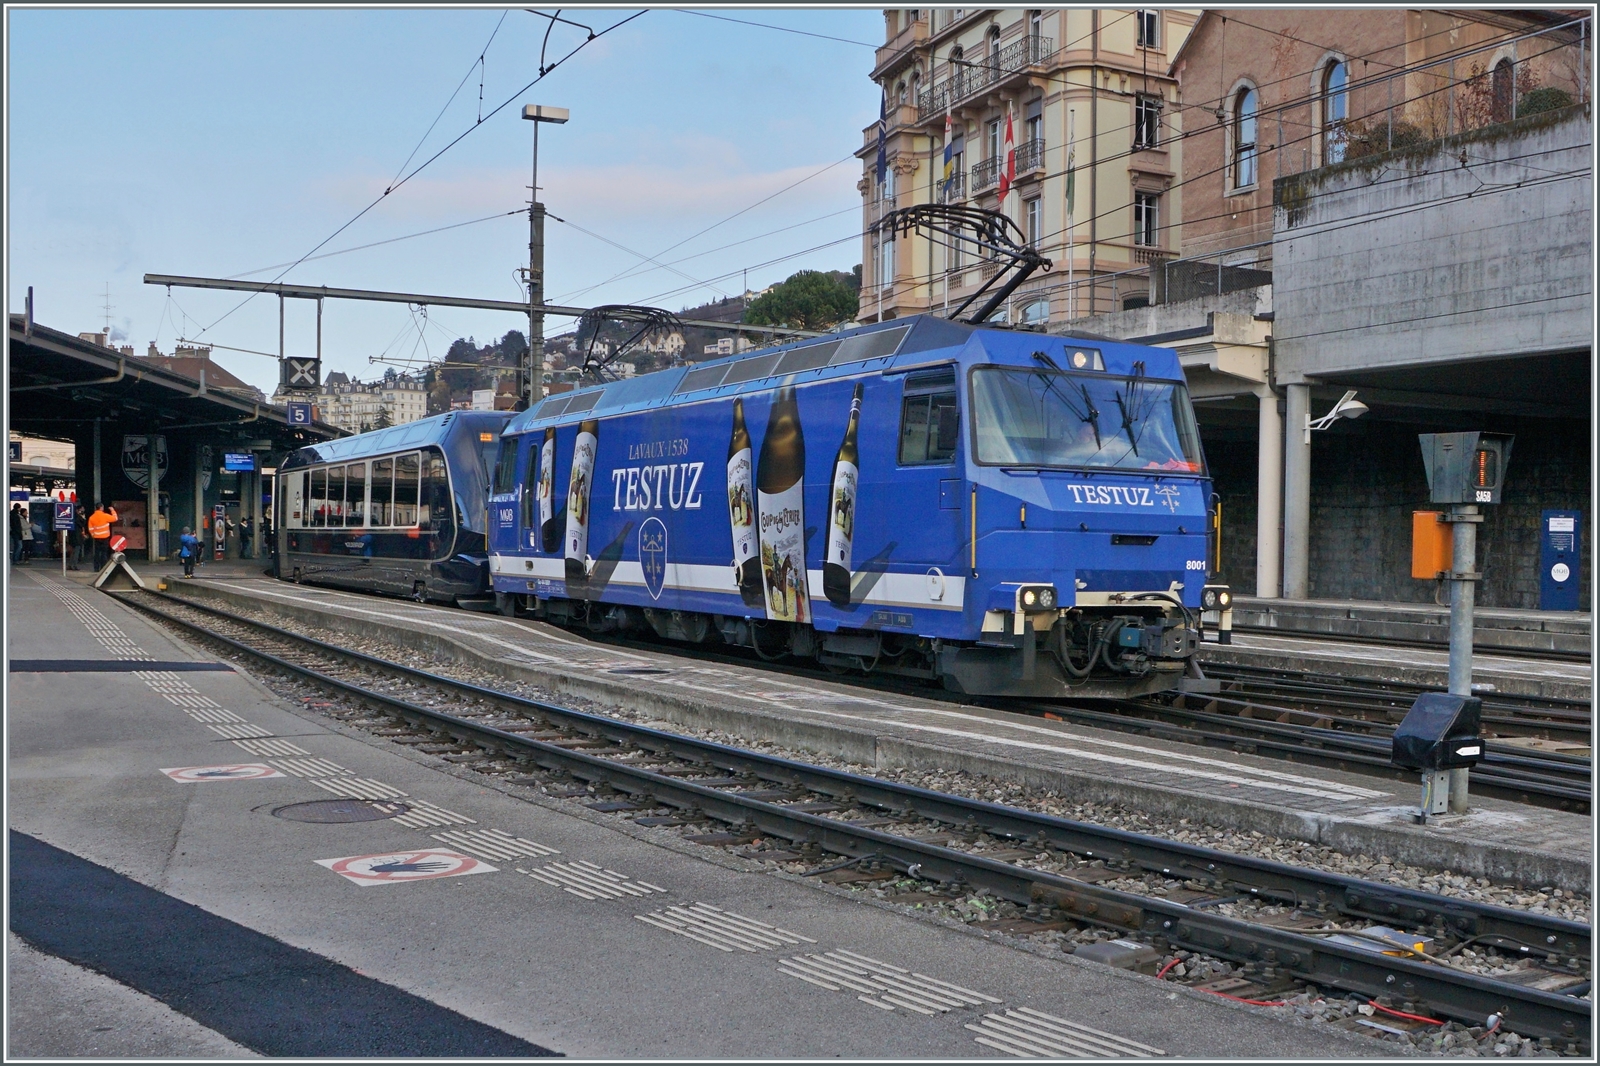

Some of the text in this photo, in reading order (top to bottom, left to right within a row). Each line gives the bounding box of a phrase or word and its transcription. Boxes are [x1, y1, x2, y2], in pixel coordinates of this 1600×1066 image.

[294, 409, 305, 422] 5
[612, 462, 704, 511] TESTUZ
[1067, 484, 1154, 506] TESTUZ
[1186, 560, 1206, 570] 8001
